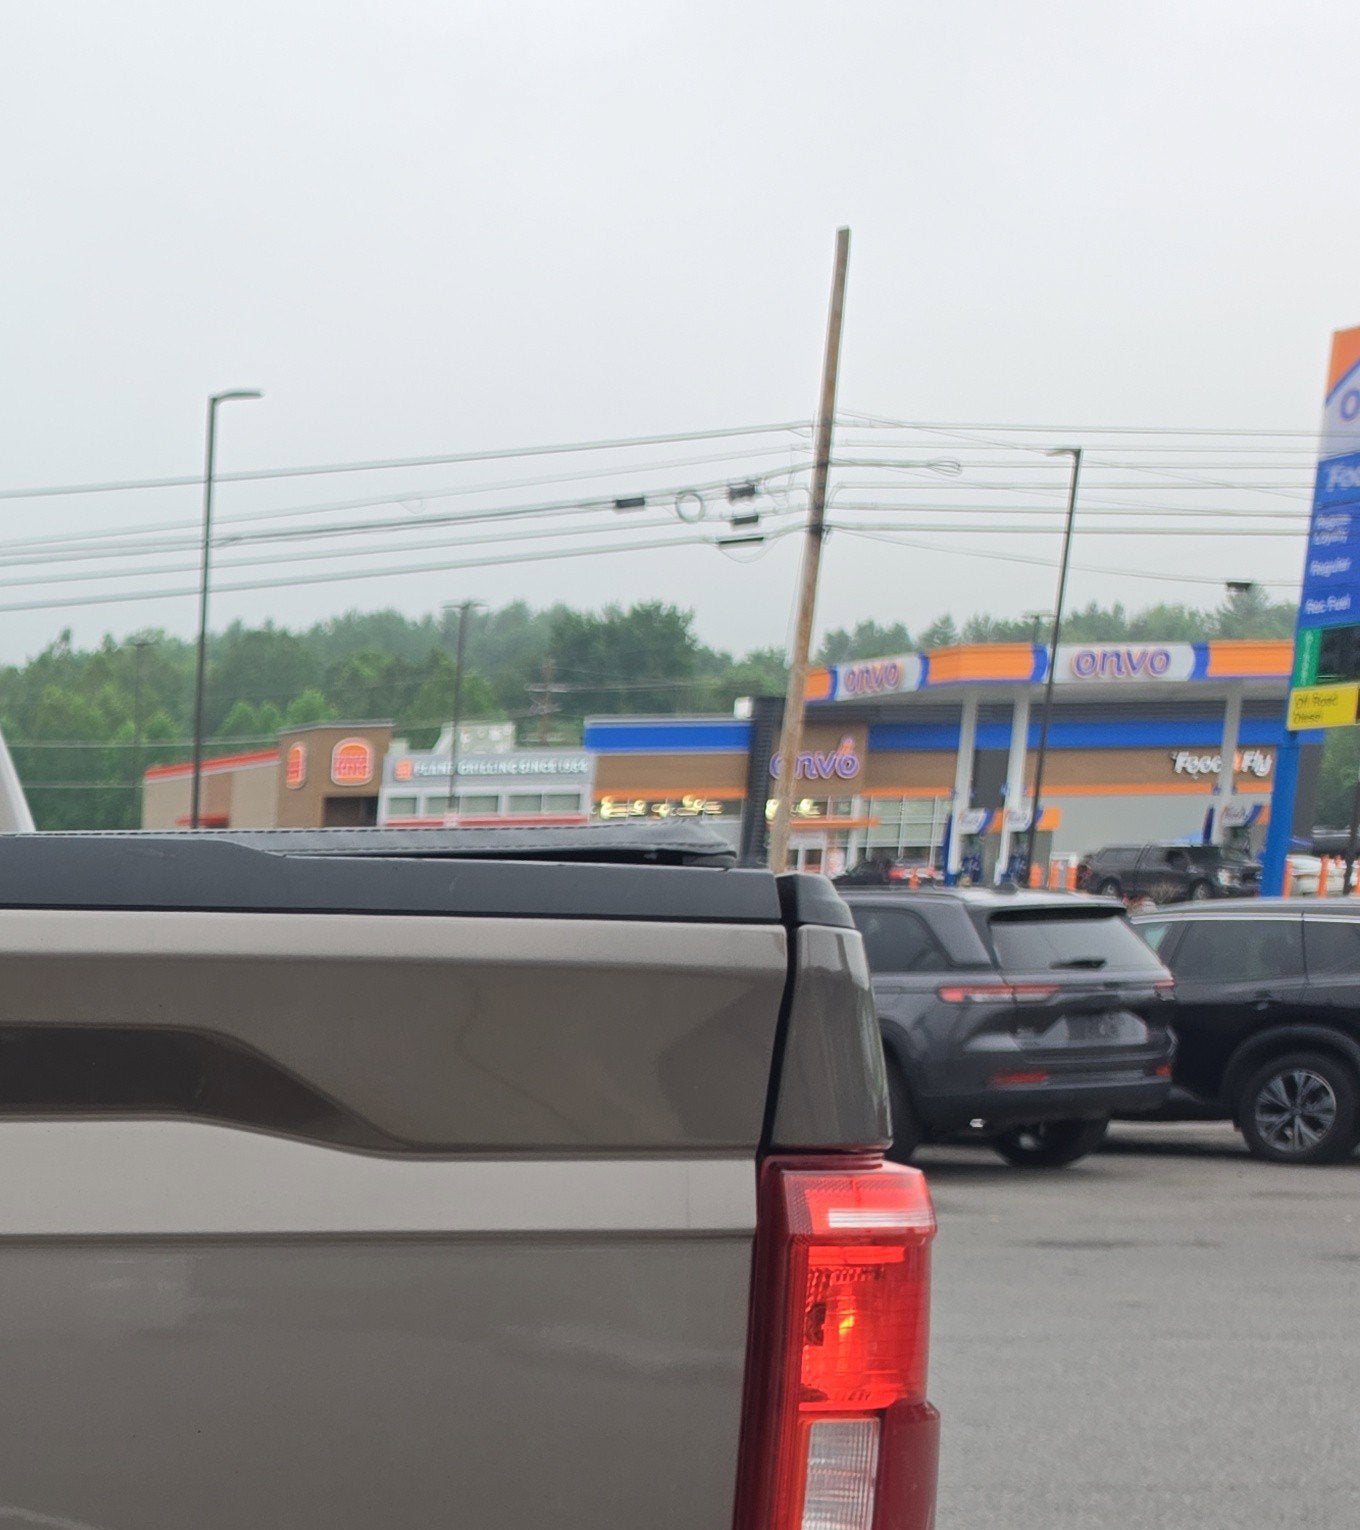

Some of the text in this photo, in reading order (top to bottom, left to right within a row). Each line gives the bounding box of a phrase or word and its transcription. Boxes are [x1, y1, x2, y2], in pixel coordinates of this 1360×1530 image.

[842, 661, 901, 695] onvo
[1073, 646, 1173, 678] onvo
[1241, 750, 1272, 777] Fly
